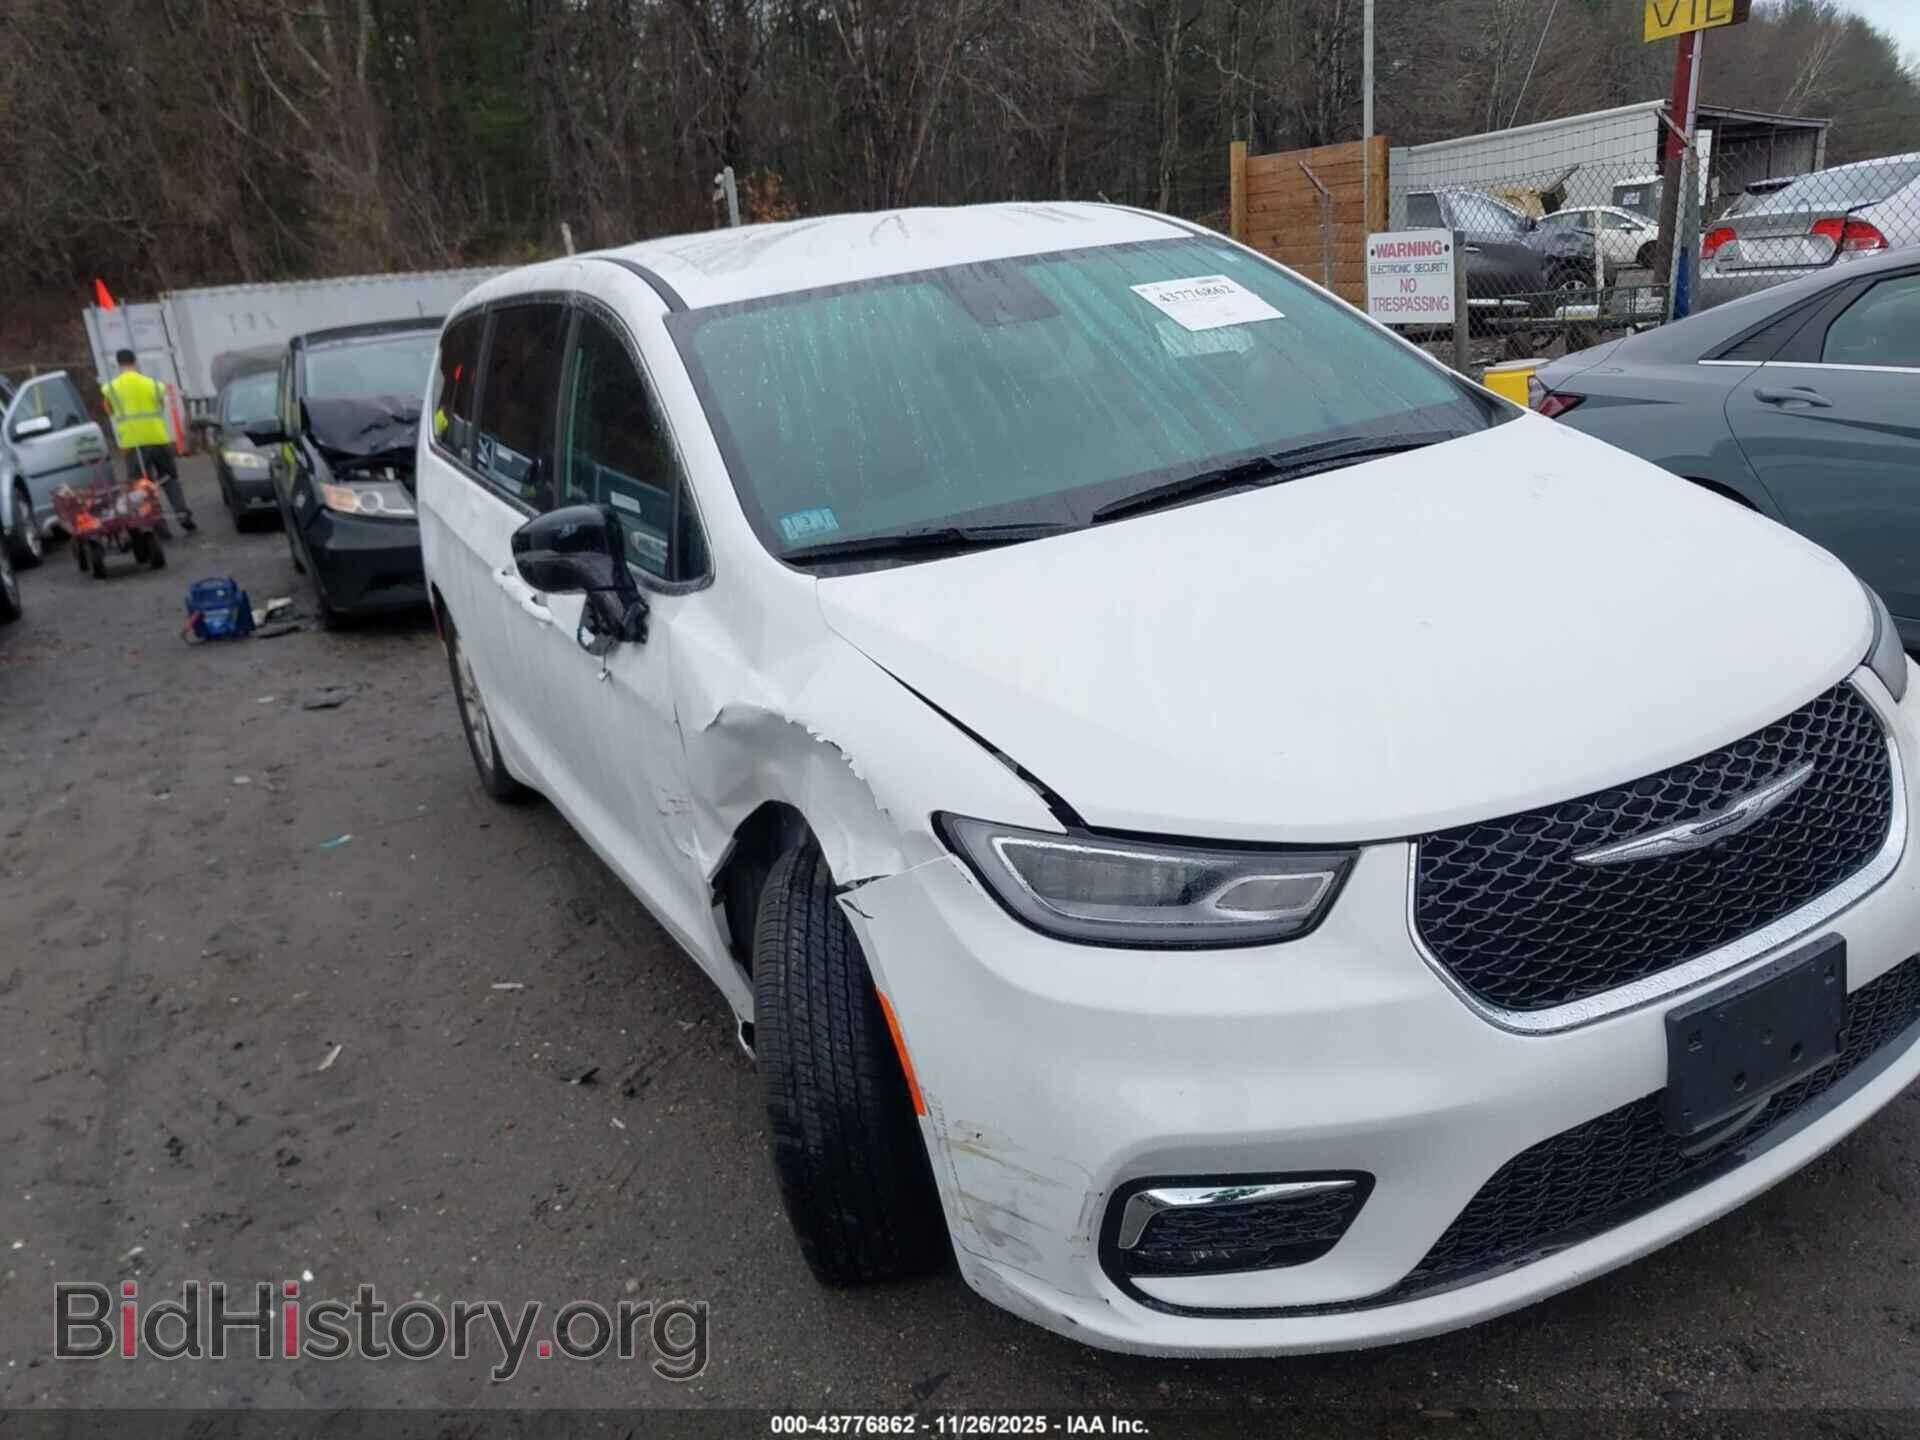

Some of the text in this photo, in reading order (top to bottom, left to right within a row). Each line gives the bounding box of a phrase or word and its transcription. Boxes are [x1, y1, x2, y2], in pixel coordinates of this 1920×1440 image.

[1375, 240, 1442, 258] WARNING
[1370, 263, 1448, 274] ELECTRONIC SECURITY
[1400, 278, 1417, 293] NO
[1158, 285, 1236, 303] 43776862
[1372, 296, 1449, 312] TRESPASSING
